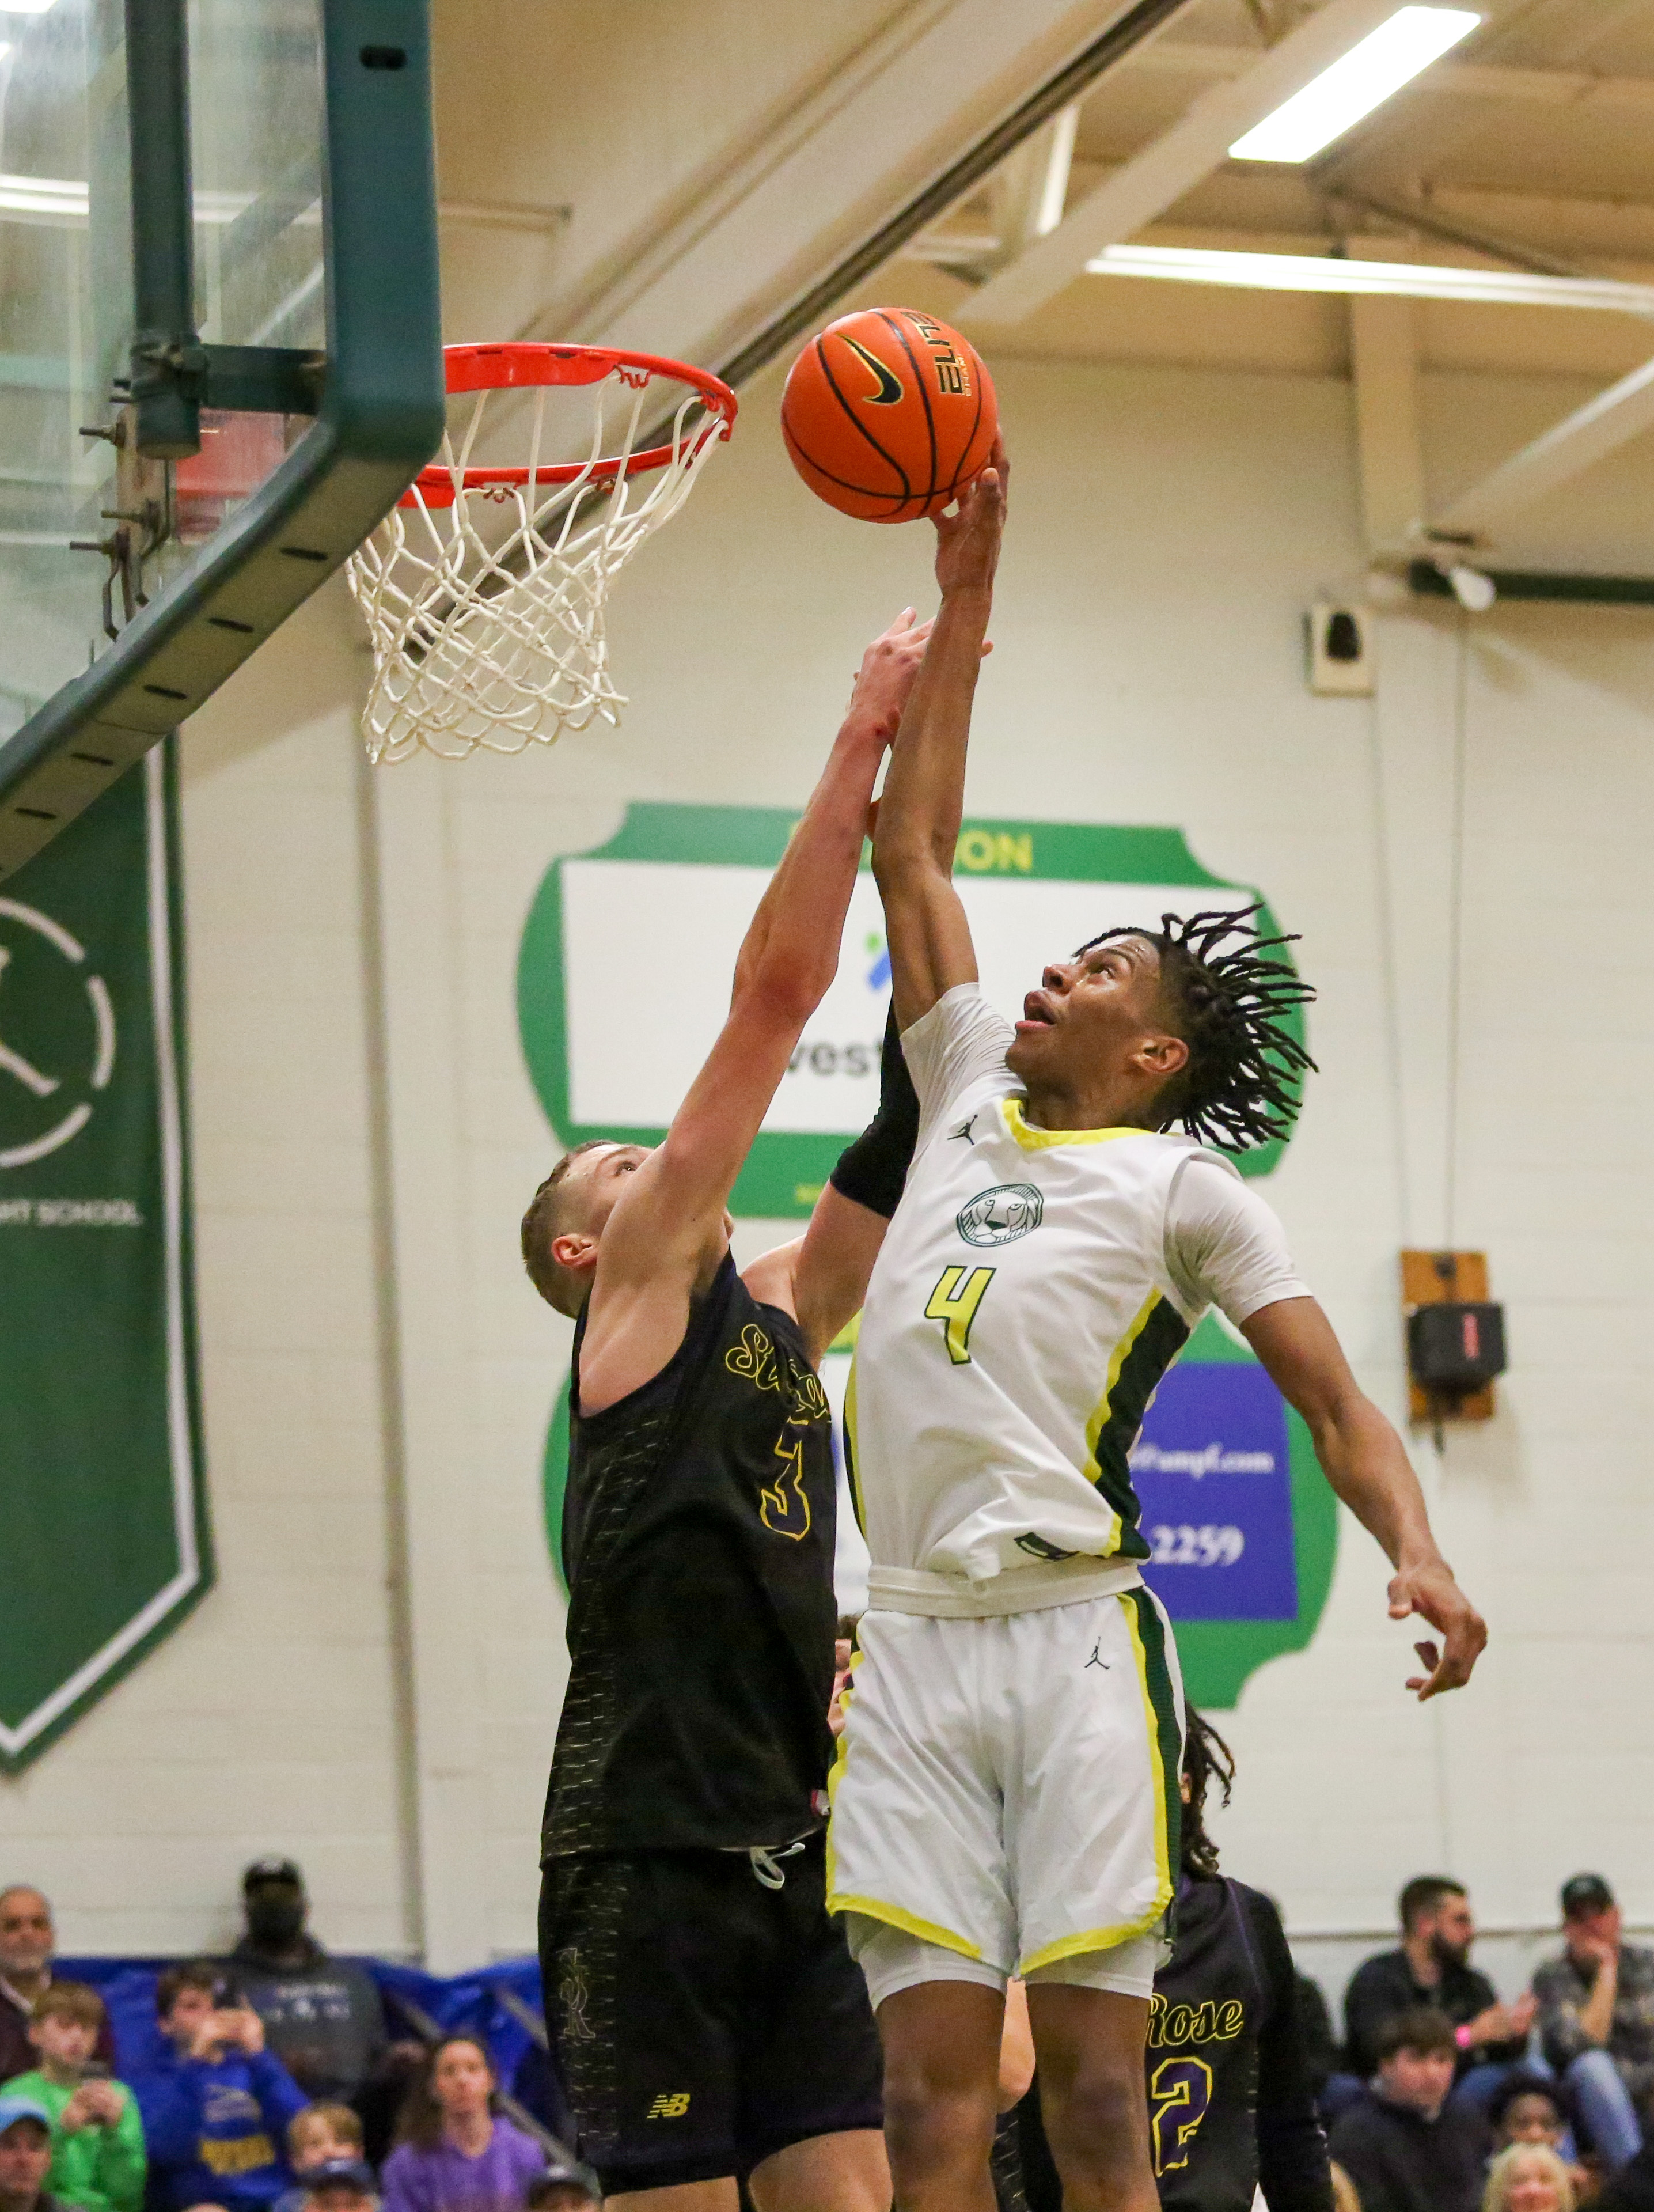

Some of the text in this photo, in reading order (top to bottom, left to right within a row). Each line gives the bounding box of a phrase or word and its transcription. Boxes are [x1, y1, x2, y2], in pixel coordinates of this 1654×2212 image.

[924, 1265, 997, 1366] 4
[1152, 1524, 1245, 1567] 2259
[646, 2093, 691, 2119] NB
[1152, 2056, 1213, 2178] 2
